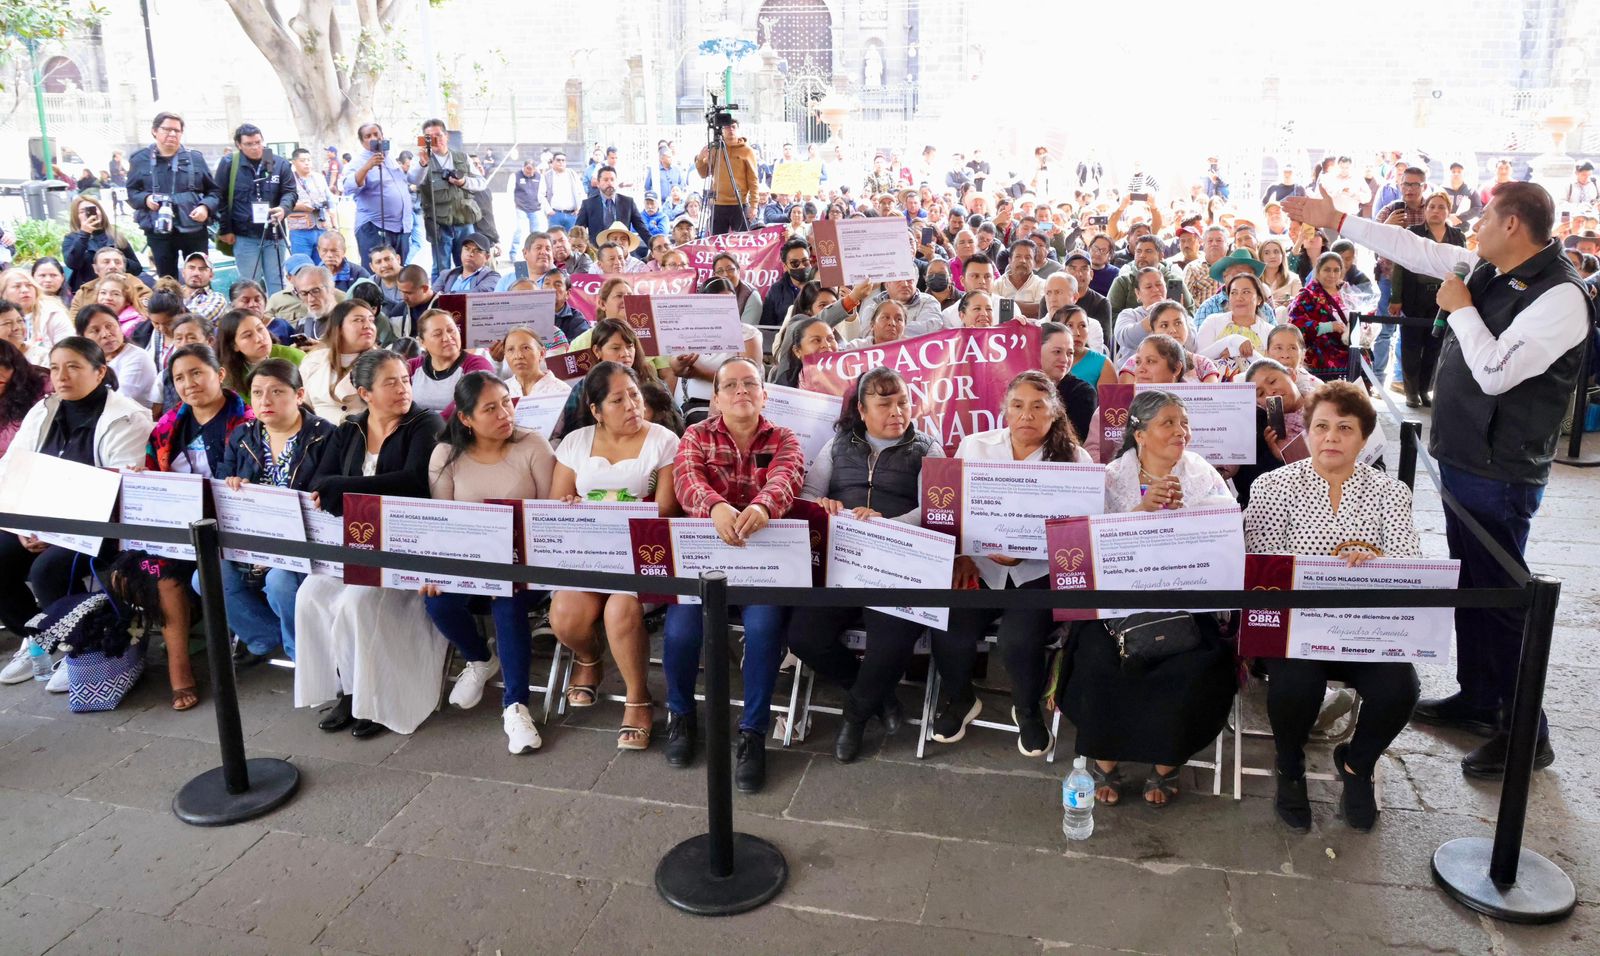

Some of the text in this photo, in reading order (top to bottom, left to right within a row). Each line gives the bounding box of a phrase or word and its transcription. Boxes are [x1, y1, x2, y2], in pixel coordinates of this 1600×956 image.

[695, 250, 751, 266] SEOR
[908, 376, 979, 407] ÑOR
[927, 513, 954, 521] OBRA
[846, 527, 866, 536] ANTONIA
[880, 568, 903, 579] diciembre
[1057, 576, 1086, 585] OBRA
[1248, 614, 1280, 623] OBRA
